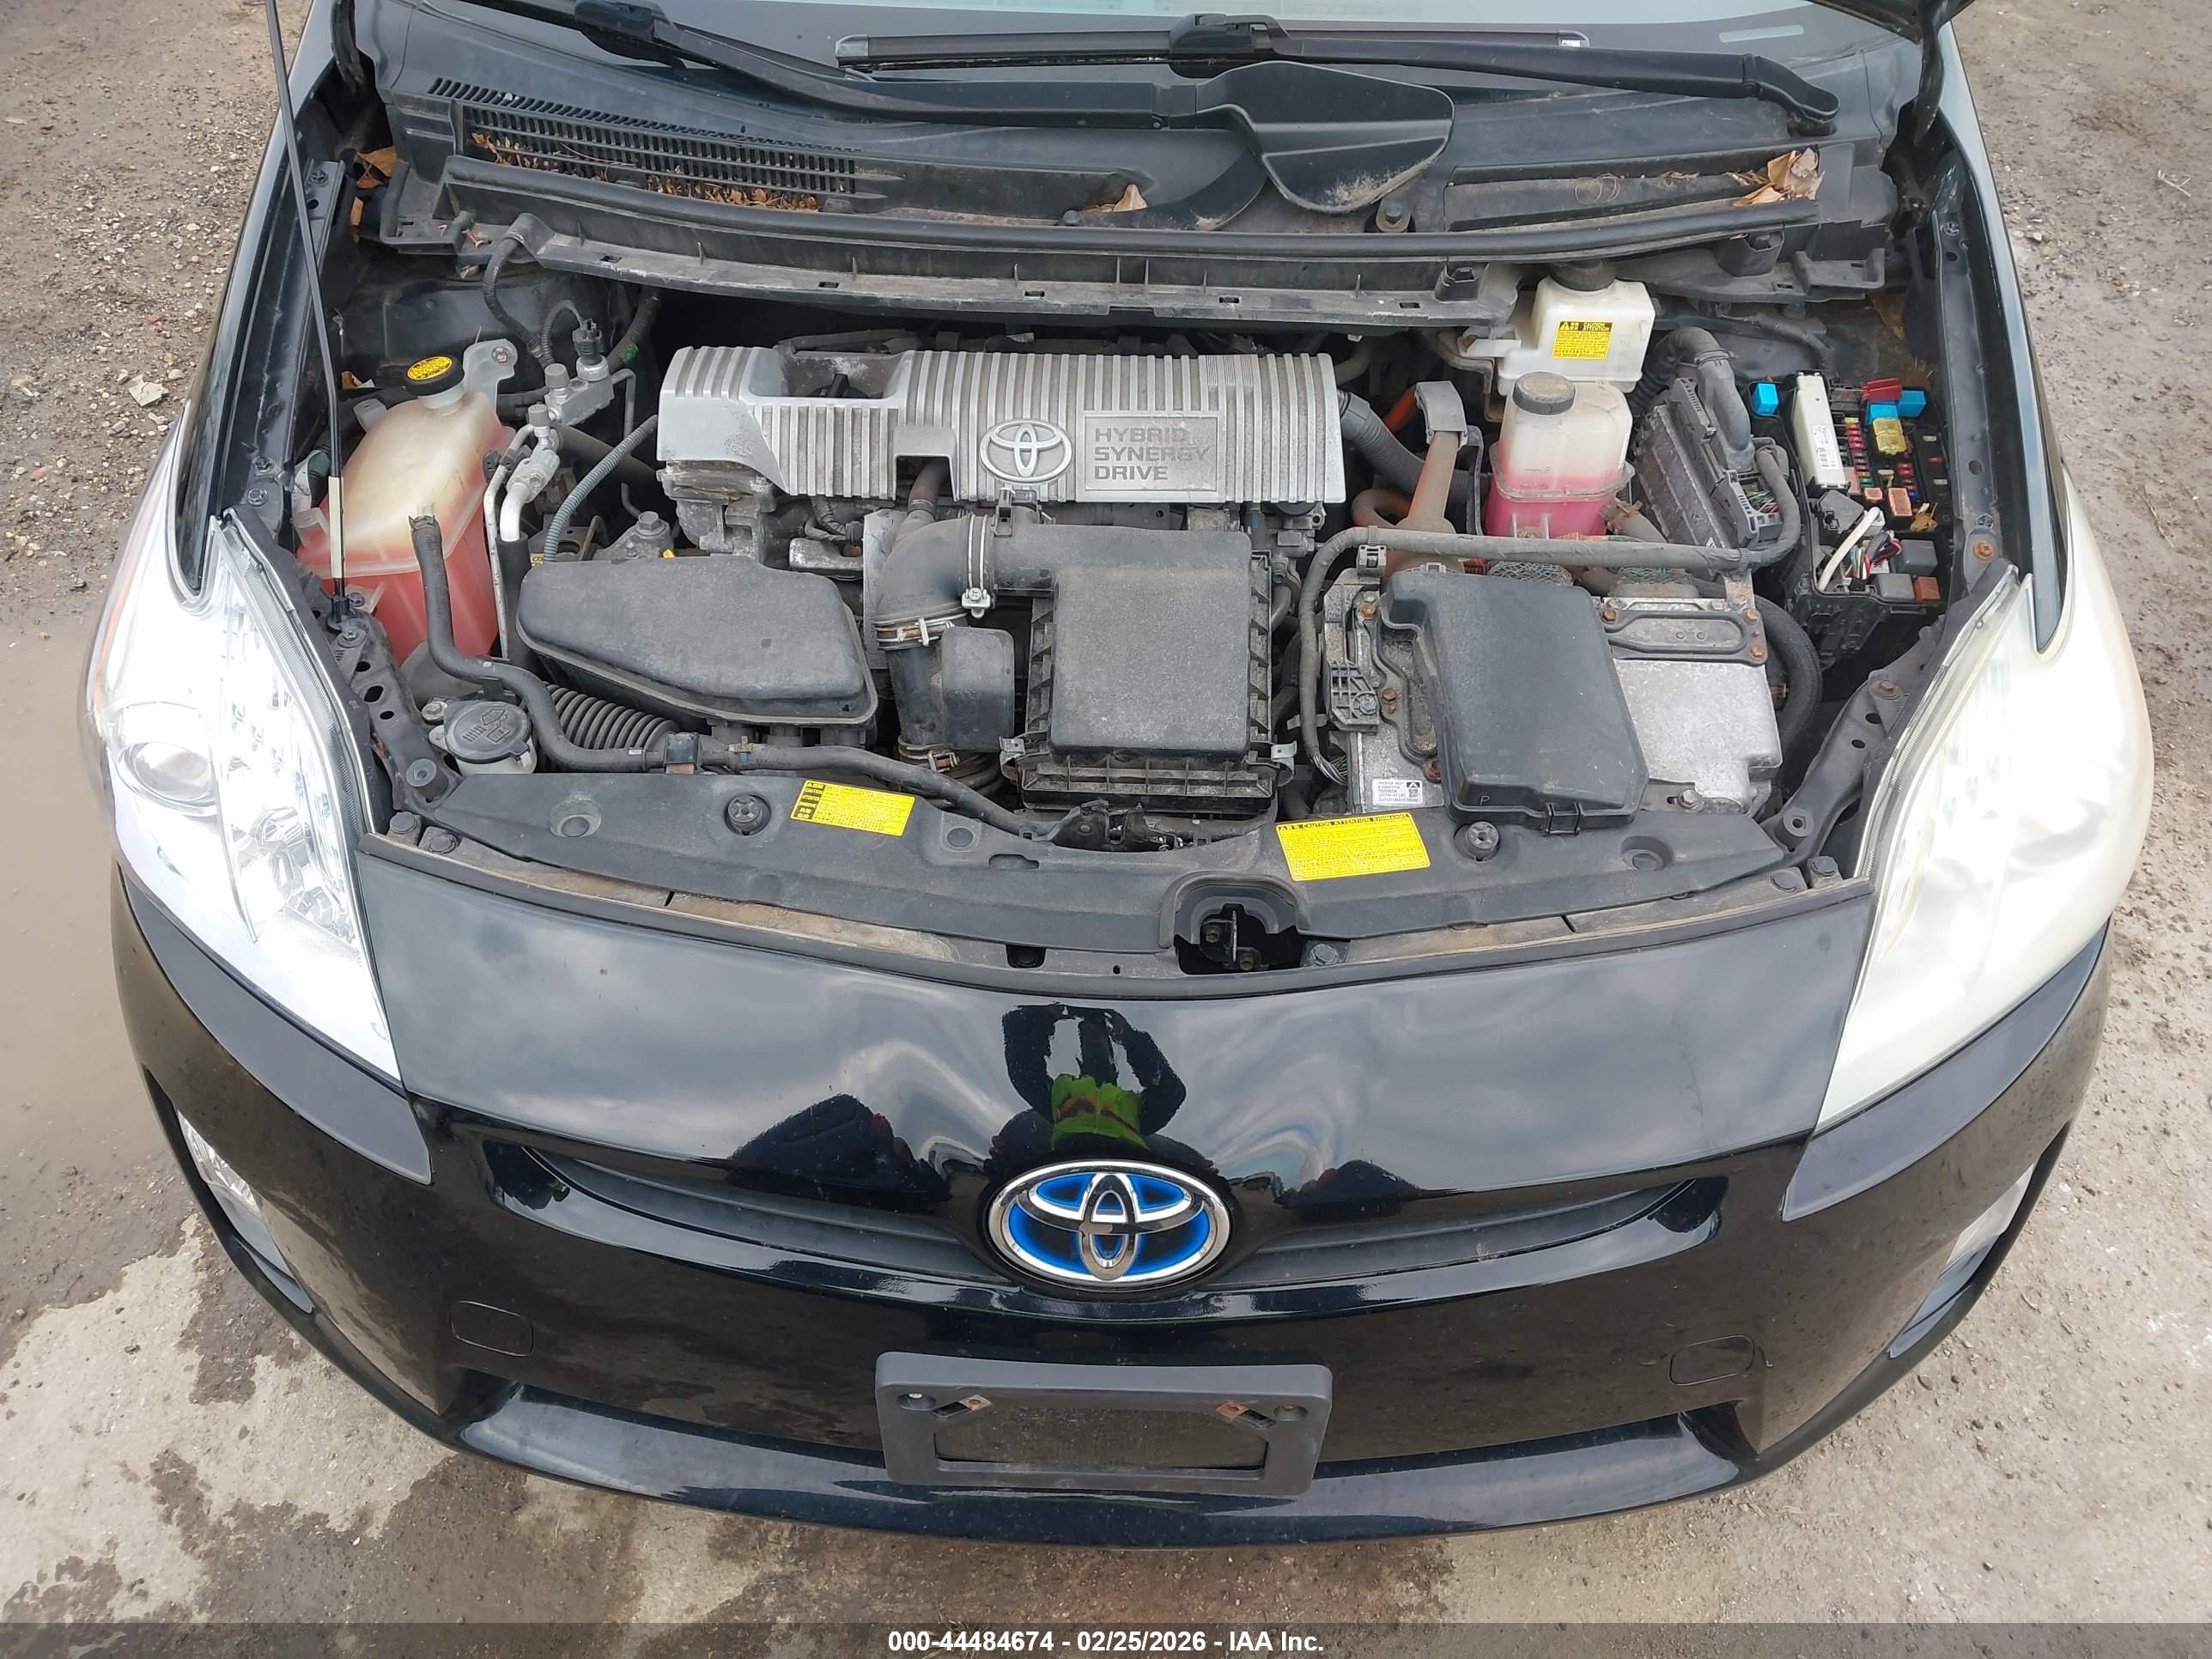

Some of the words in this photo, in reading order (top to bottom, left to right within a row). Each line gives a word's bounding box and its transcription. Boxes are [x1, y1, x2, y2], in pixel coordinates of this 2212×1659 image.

[1095, 428, 1189, 442] HYBRID
[1094, 446, 1209, 461] SYNERGY
[1094, 465, 1169, 481] DRIVE
